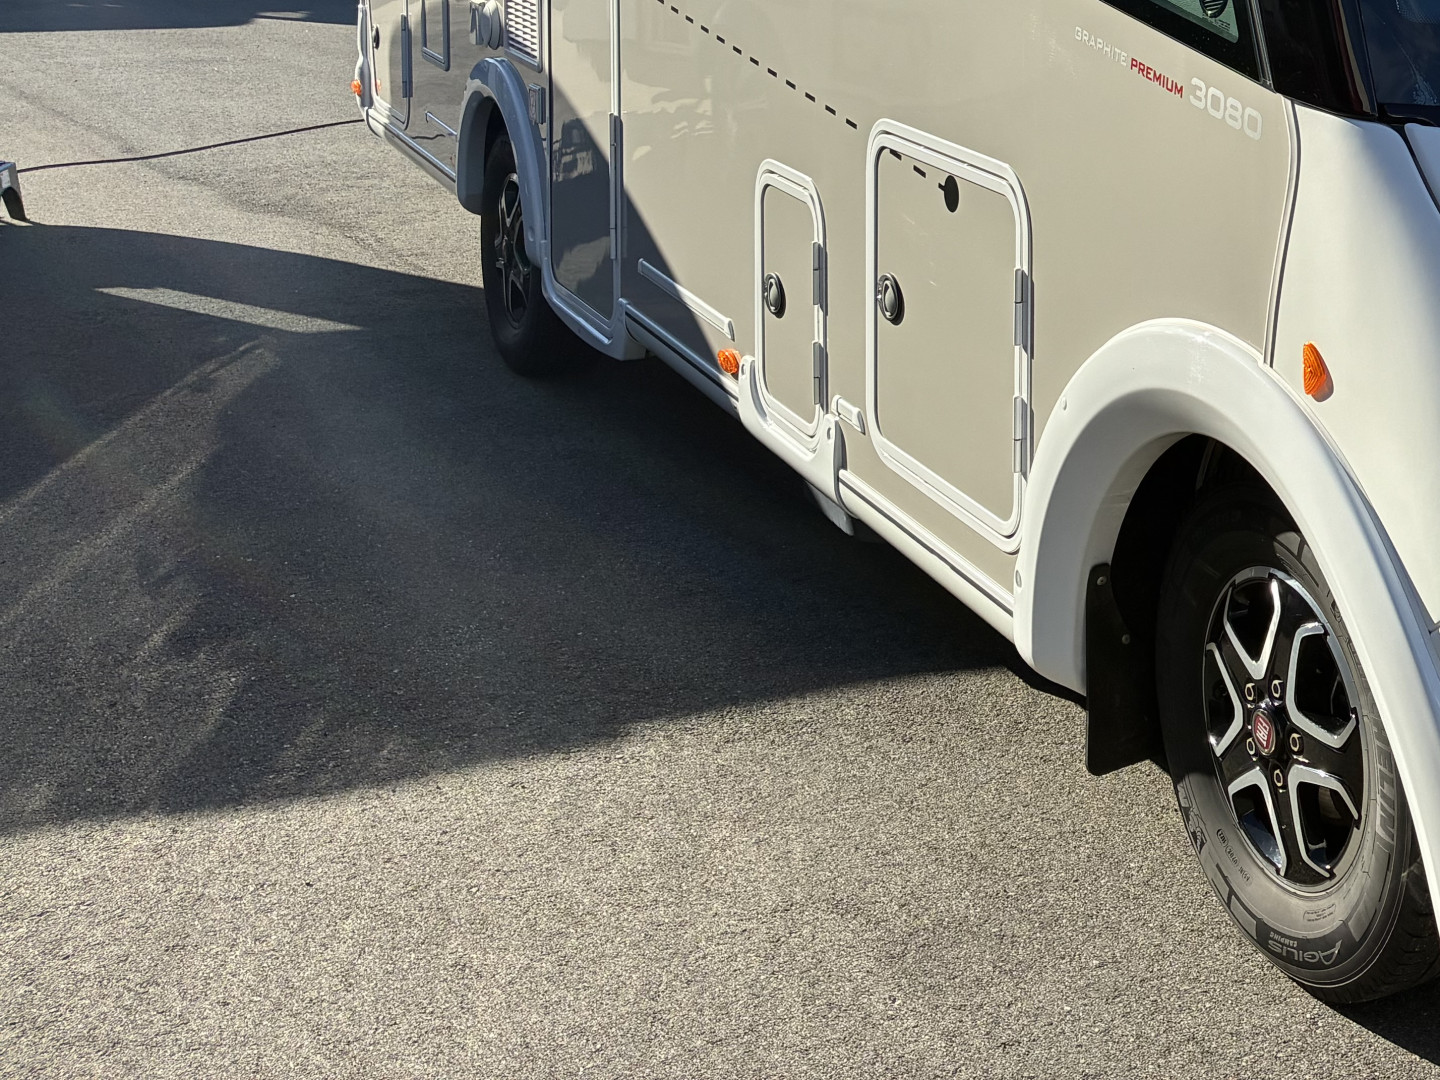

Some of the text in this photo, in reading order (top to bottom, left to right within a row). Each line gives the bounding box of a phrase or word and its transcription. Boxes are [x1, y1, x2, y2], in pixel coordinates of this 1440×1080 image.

[1074, 26, 1263, 141] GRAPHITE PREMIUM 3080
[1256, 717, 1270, 748] FIAT
[1268, 939, 1342, 965] AGILIS
[1269, 931, 1298, 948] CAMPING
